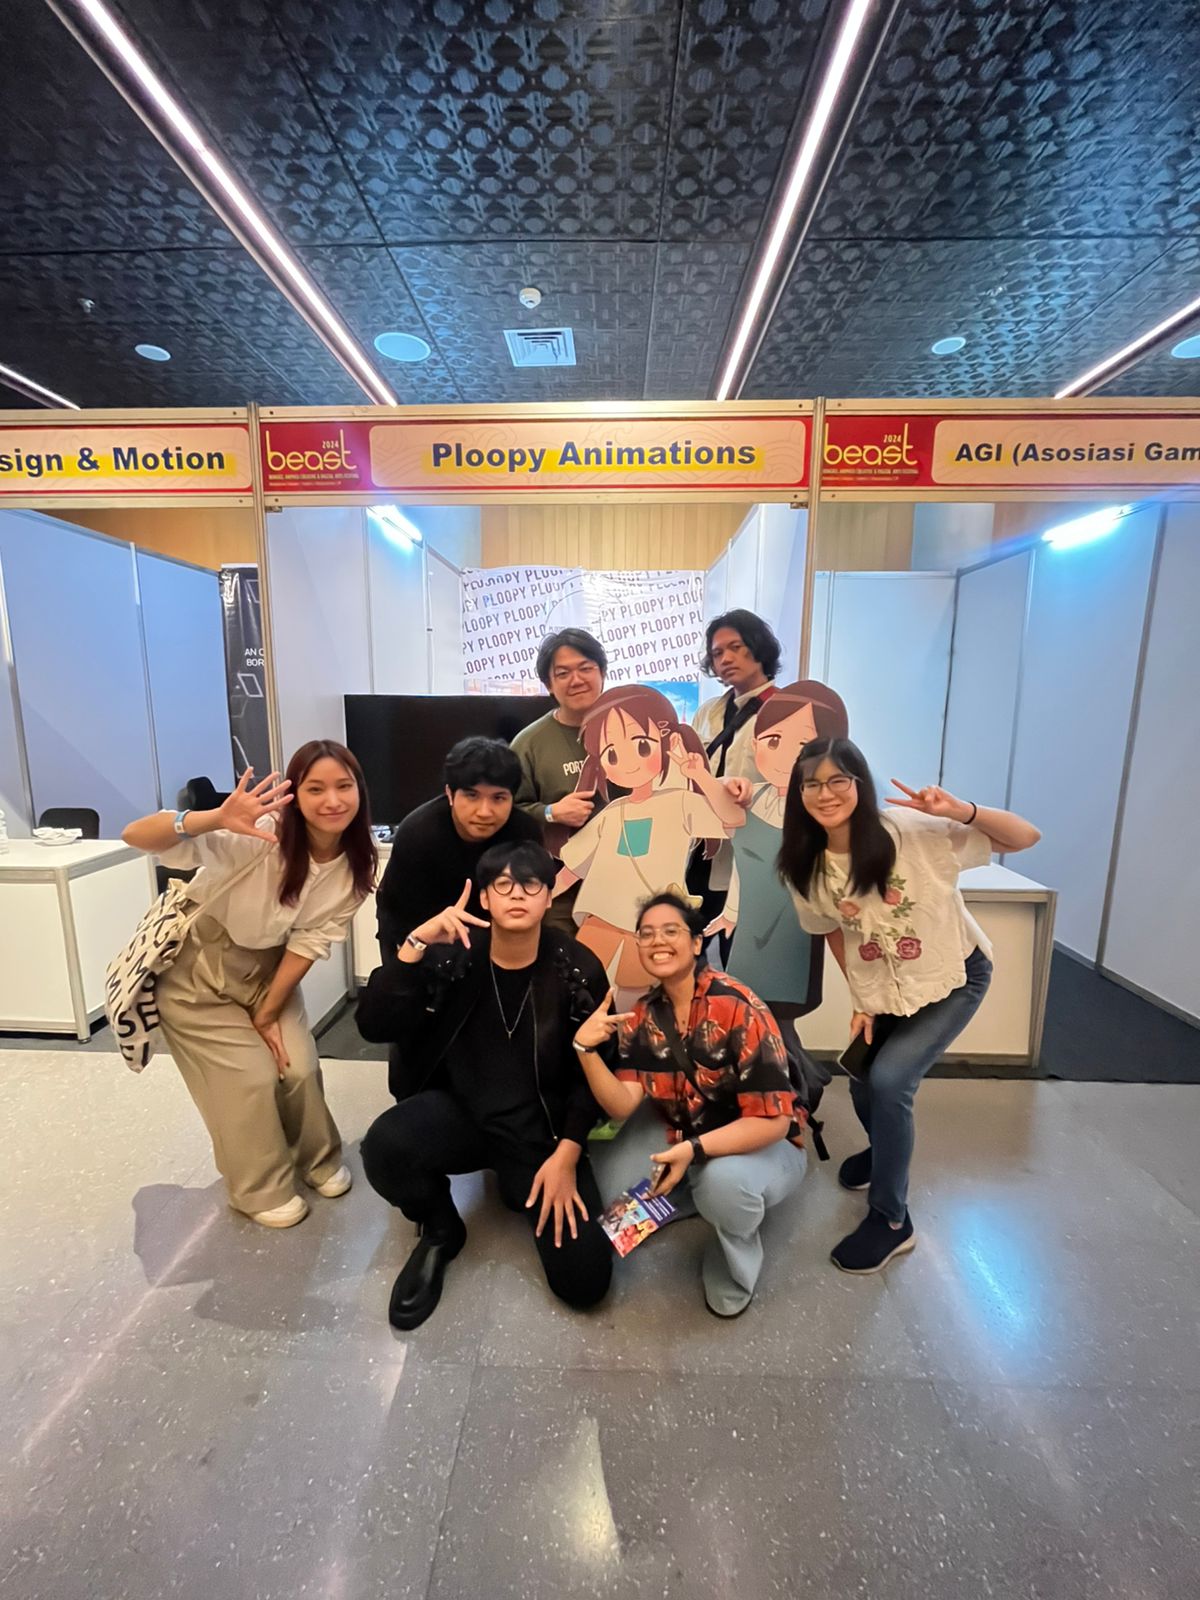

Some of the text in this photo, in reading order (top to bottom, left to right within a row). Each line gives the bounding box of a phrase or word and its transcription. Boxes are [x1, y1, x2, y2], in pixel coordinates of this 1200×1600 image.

[322, 440, 339, 449] 2024
[824, 422, 918, 466] beast
[883, 434, 902, 443] 2024
[77, 447, 100, 471] &
[113, 446, 225, 471] Motion
[265, 430, 357, 471] beast
[432, 440, 756, 473] Ploopy Animations
[955, 443, 1003, 462] AGI
[1013, 442, 1136, 466] (Asosiasi
[482, 586, 526, 608] PLOOPY
[620, 597, 664, 619] PLOOPY
[503, 602, 547, 624] PLOOPY
[641, 613, 685, 635] PLOOPY
[478, 629, 521, 651] PLOOPY
[614, 640, 657, 660] PLOOPY
[245, 648, 257, 656] AN
[636, 657, 679, 677] PLOOPY
